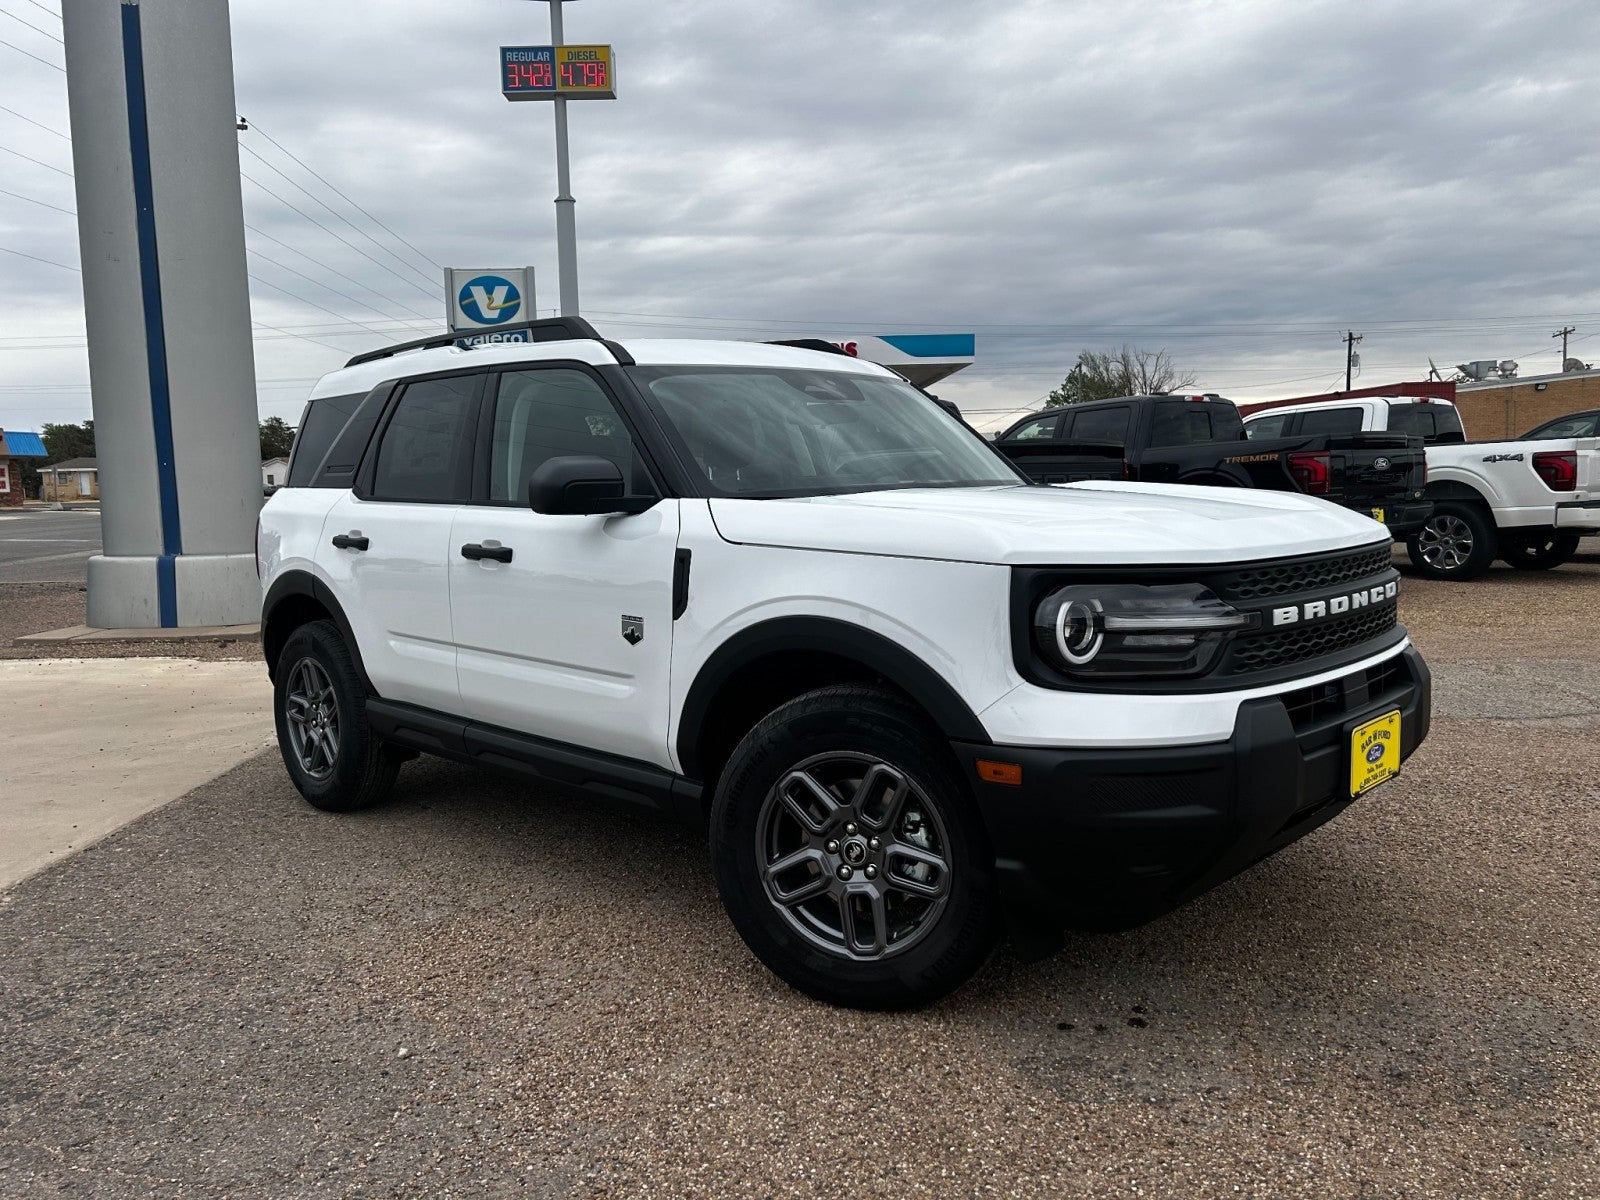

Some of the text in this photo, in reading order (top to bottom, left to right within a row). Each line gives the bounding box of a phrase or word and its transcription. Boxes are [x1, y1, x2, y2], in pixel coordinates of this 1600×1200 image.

[506, 51, 550, 62] REGULAR
[567, 51, 600, 61] DIESEL
[1223, 453, 1279, 464] TREMOR
[1272, 581, 1397, 626] BRONCO
